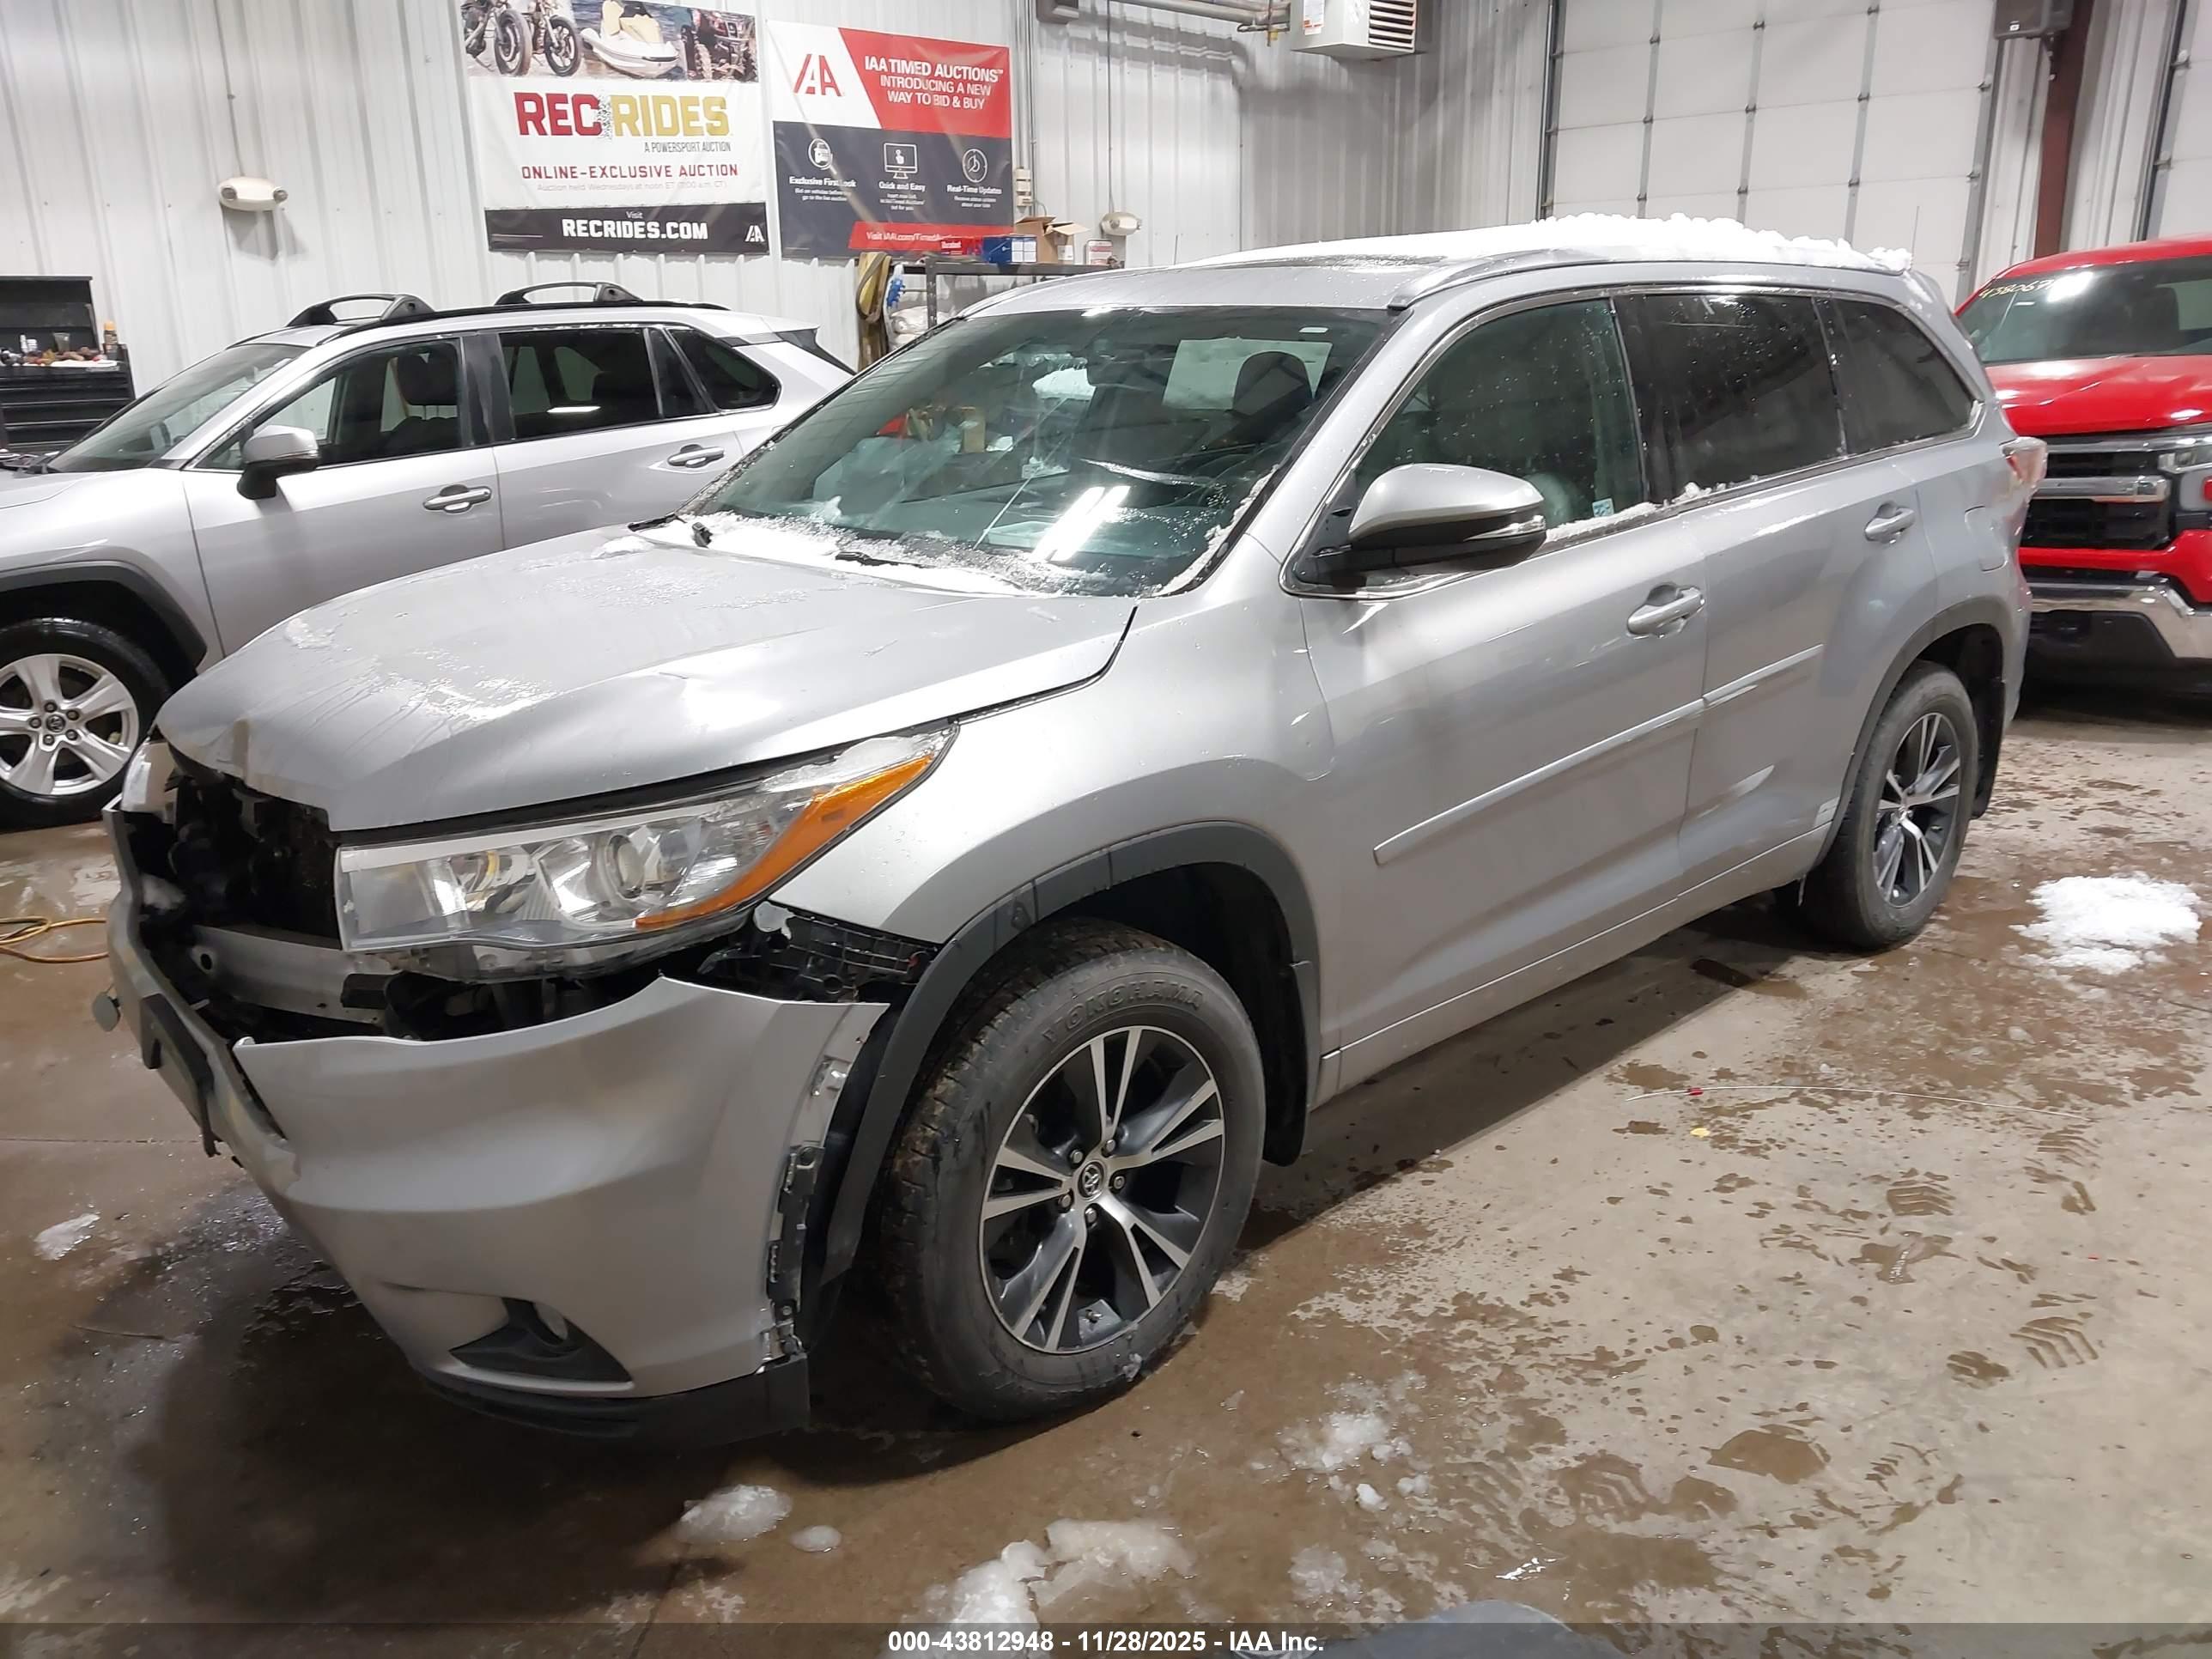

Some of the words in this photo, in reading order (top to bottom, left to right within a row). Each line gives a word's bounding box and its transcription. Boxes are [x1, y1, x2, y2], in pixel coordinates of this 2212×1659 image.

[865, 56, 888, 72] IAA
[889, 58, 931, 76] TIMED
[880, 74, 954, 92] INTRODUCING
[957, 82, 965, 93] A
[967, 82, 991, 96] NEW
[887, 89, 912, 104] WAY
[915, 92, 931, 105] TO
[933, 93, 950, 106] BID
[952, 94, 961, 108] &
[963, 96, 985, 110] BUY
[644, 143, 651, 153] A
[651, 142, 700, 153] POWERSPORT
[702, 142, 732, 152] AUCTION
[521, 165, 672, 179] ONLINE-EXCLUSIVE
[679, 164, 738, 177] AUCTION
[789, 176, 823, 185] Exclusive
[878, 181, 896, 190] Quick
[910, 183, 926, 192] Easy
[947, 185, 978, 193] Real-Time
[979, 186, 1002, 195] Updates
[562, 219, 708, 240] RECRIDES.COM
[866, 232, 882, 240] Visit
